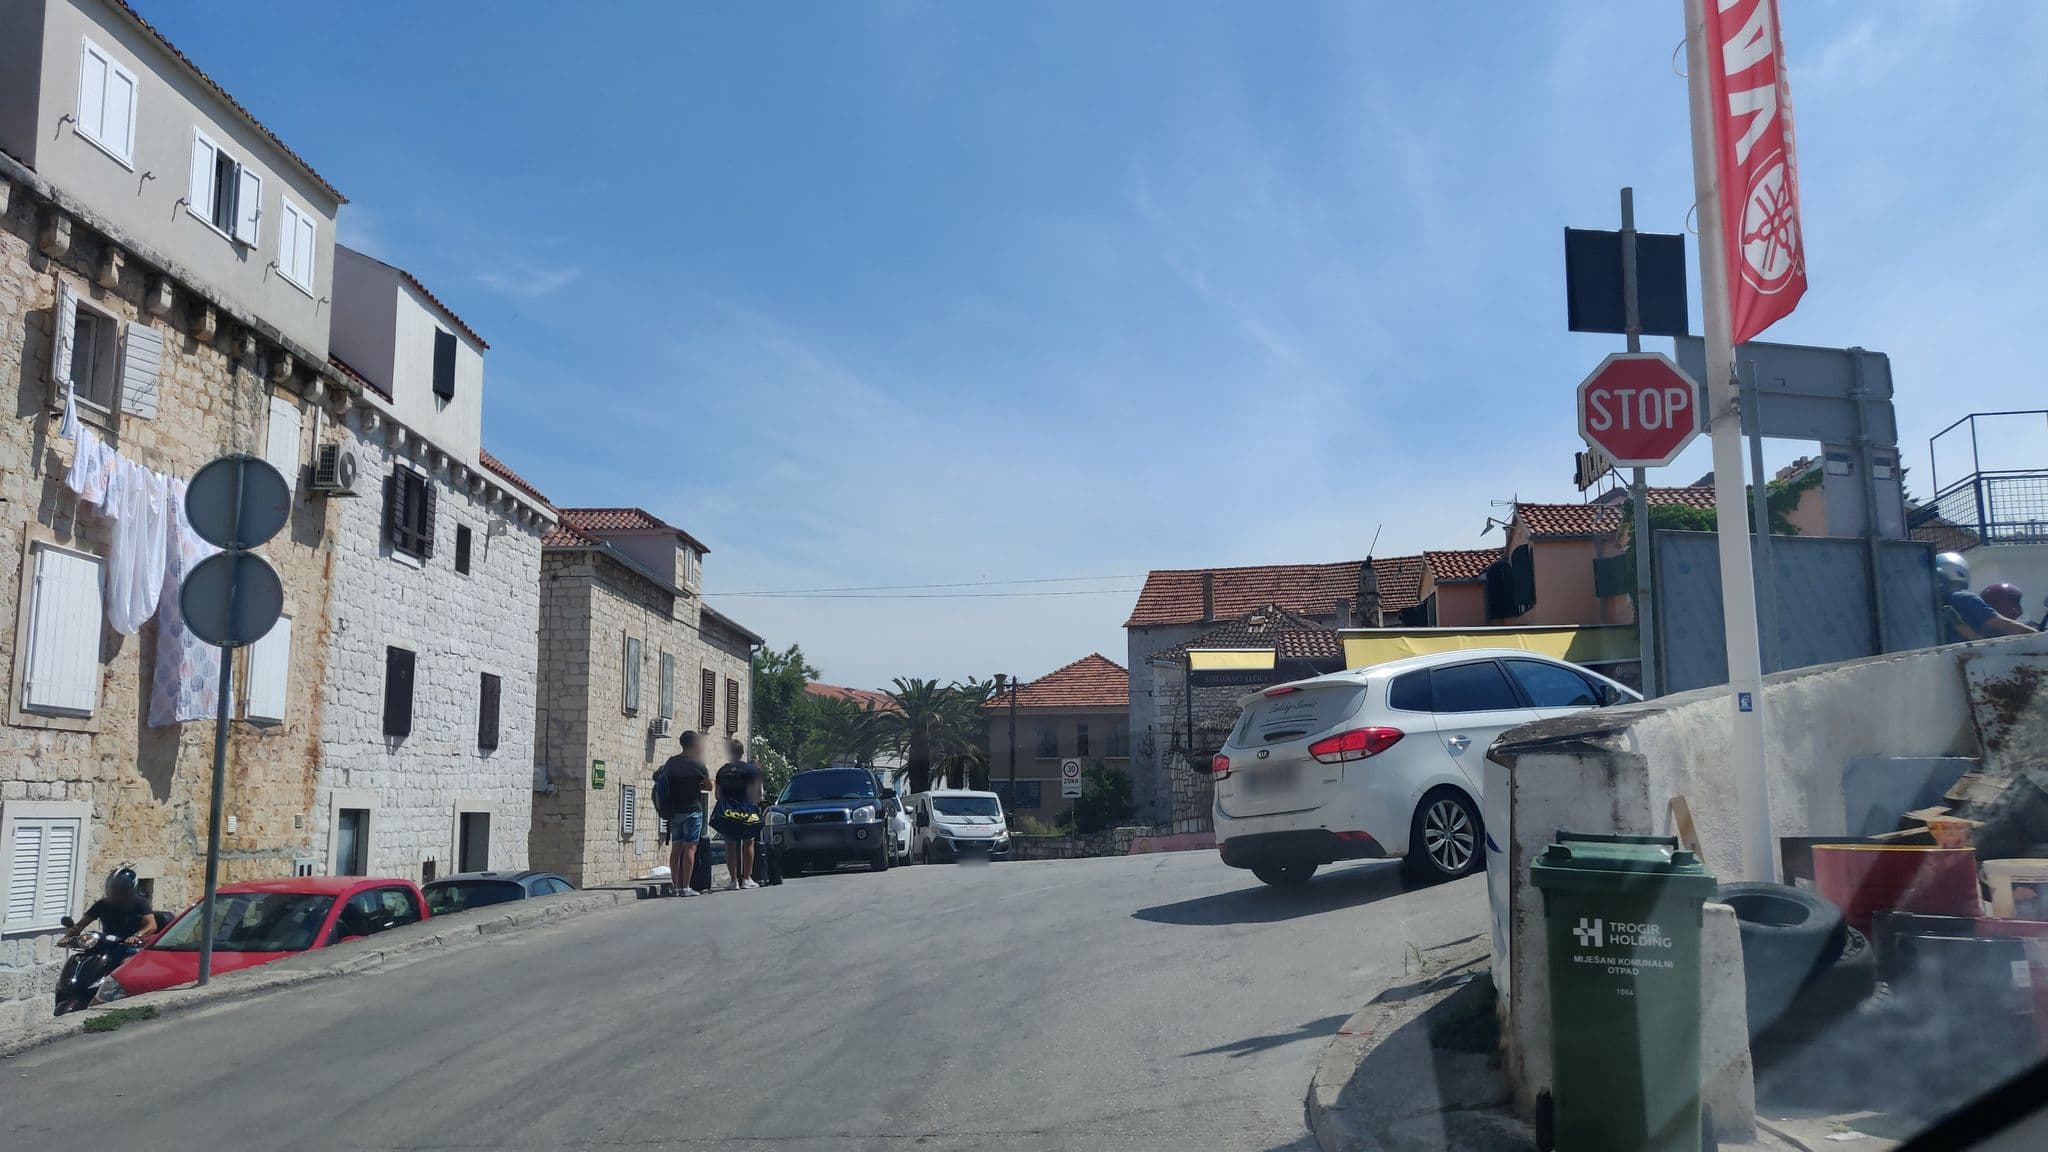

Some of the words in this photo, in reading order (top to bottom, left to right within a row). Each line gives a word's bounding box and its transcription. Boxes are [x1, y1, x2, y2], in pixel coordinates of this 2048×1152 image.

[1590, 387, 1688, 431] STOP
[1066, 765, 1075, 773] 30
[1609, 922, 1660, 934] TROGIR
[1610, 934, 1672, 948] HOLDING
[1573, 955, 1616, 965] MIJEŠANI
[1618, 958, 1674, 969] KOMUNALNI
[1607, 966, 1640, 976] OTPAD
